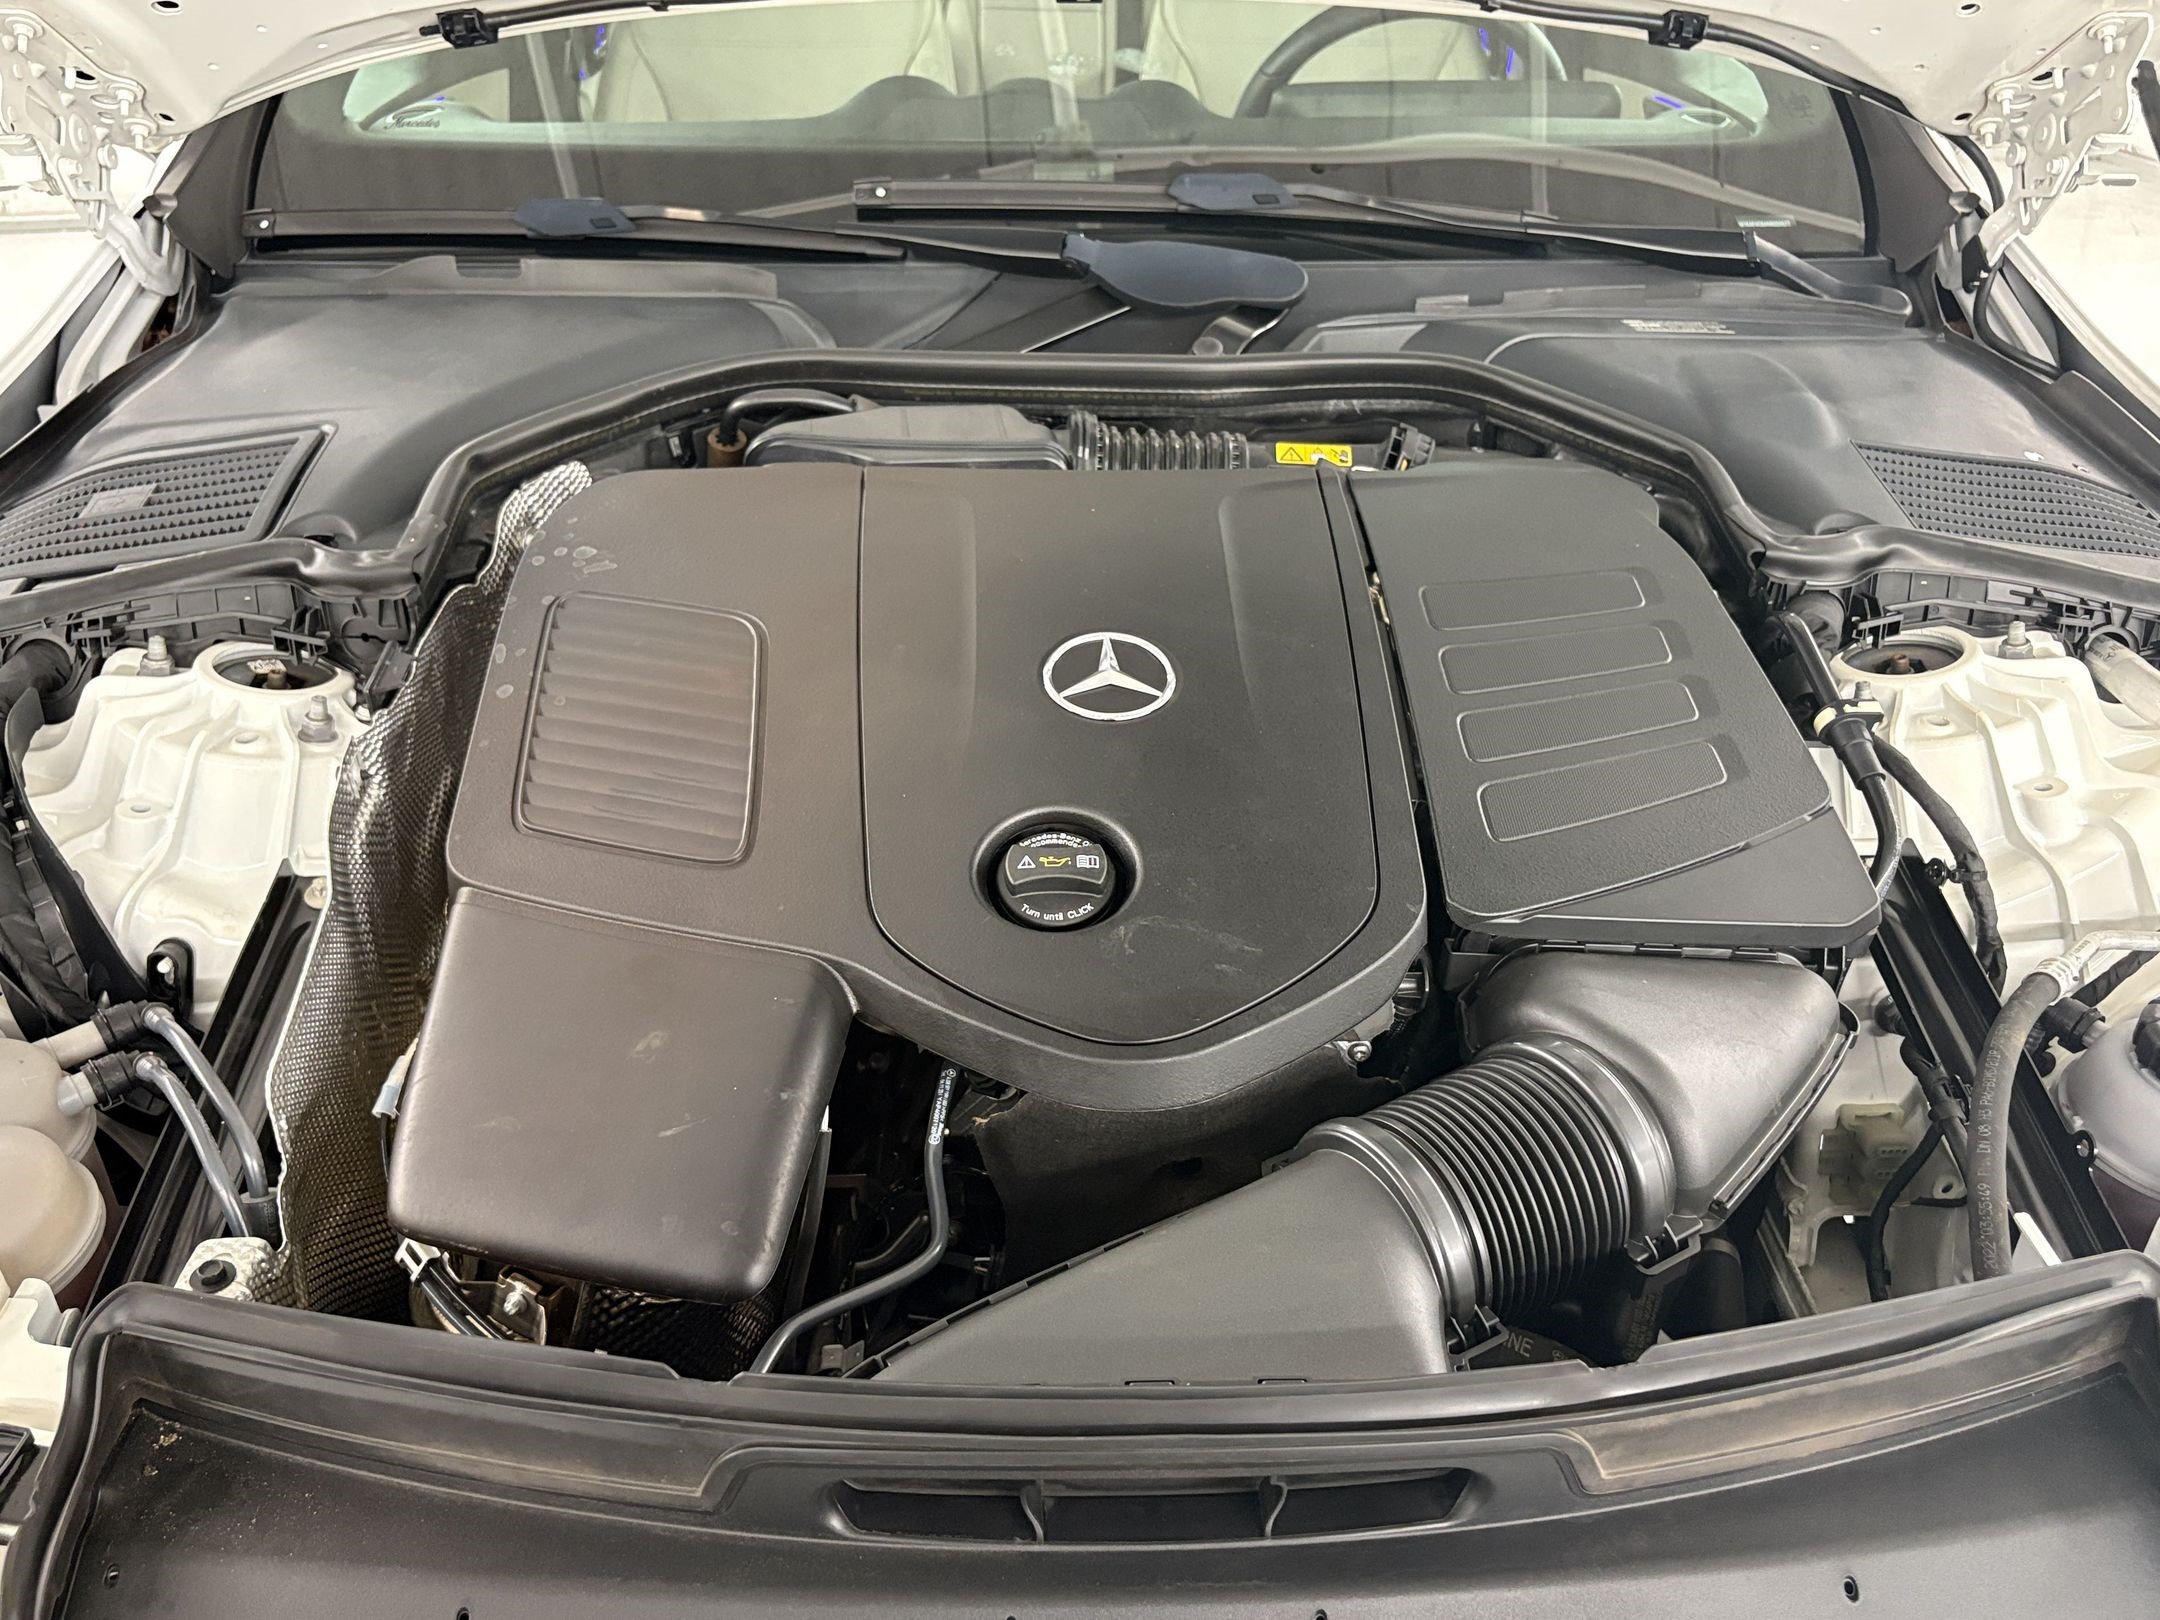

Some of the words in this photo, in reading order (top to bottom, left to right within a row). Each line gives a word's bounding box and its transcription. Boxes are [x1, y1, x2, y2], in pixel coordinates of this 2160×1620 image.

[1021, 903, 1041, 918] Turn
[1043, 912, 1064, 921] until
[1067, 902, 1095, 919] CLICK
